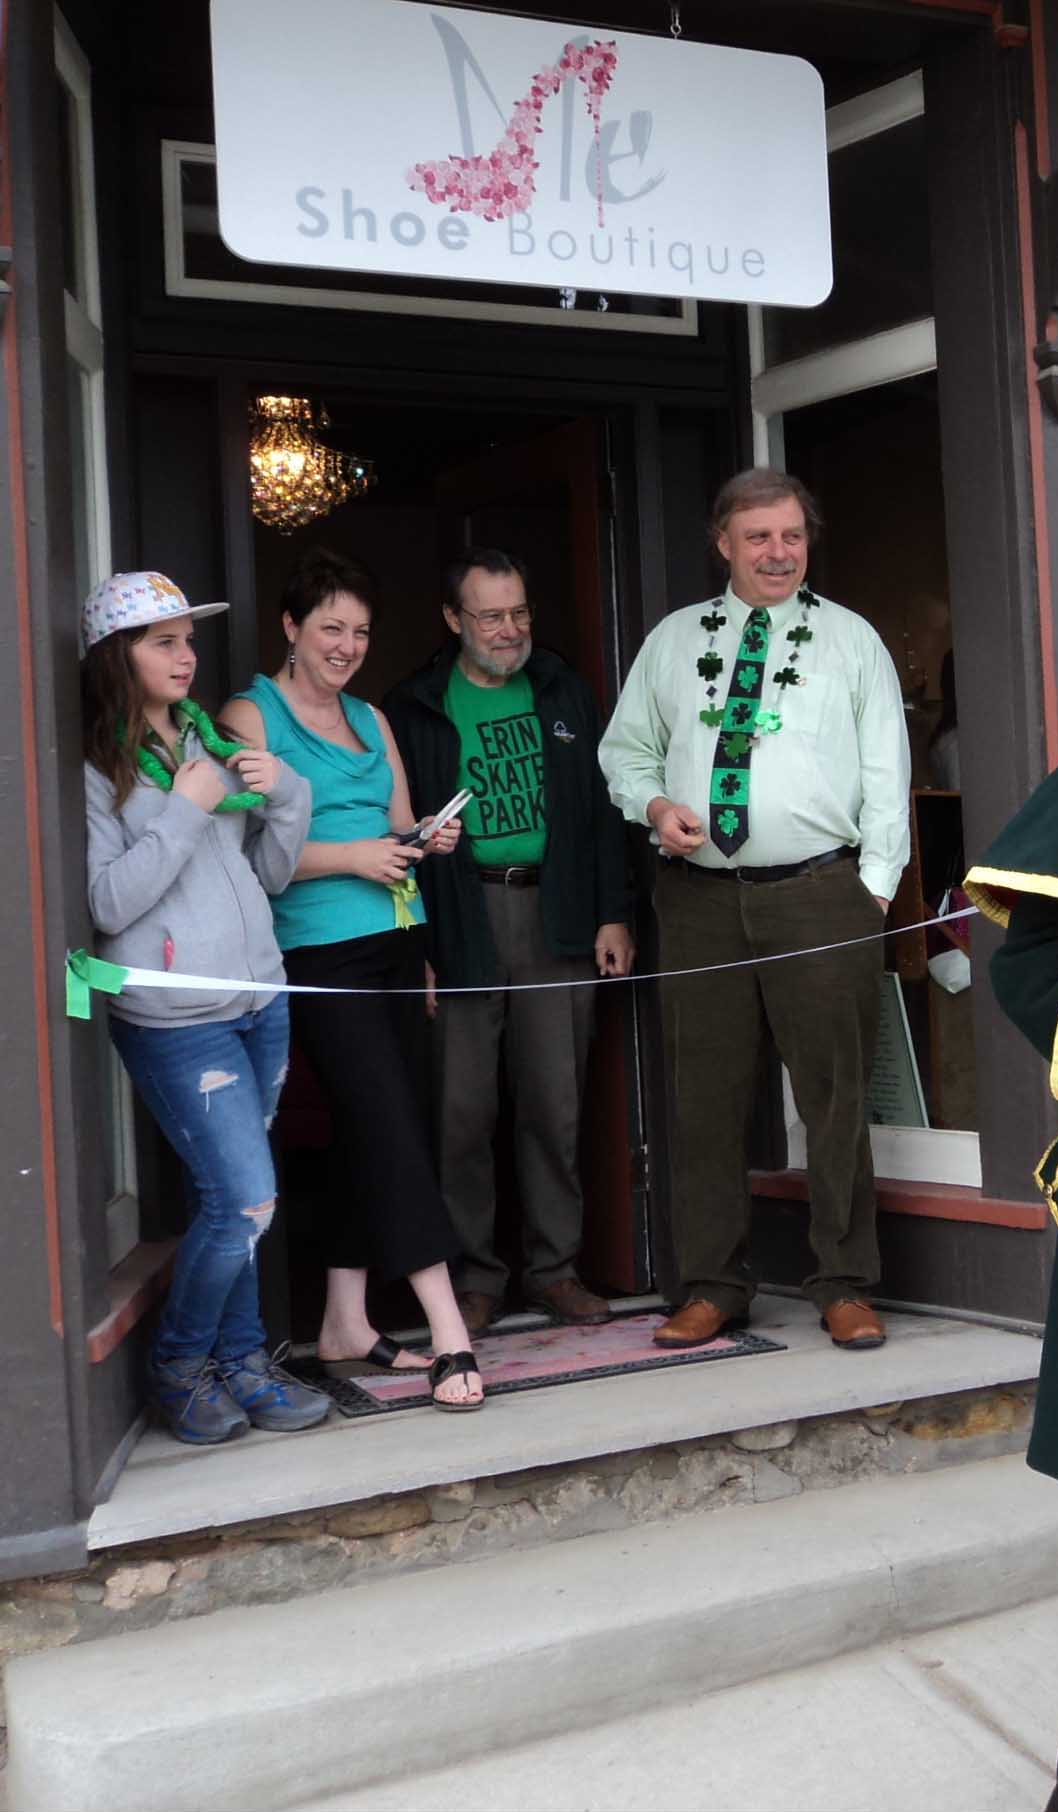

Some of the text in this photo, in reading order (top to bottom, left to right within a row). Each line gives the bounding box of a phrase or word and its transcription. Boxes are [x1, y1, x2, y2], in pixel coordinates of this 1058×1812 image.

[295, 185, 766, 284] Shoe Boutique
[476, 719, 539, 760] ERIN
[467, 752, 545, 798] SKATE
[479, 788, 546, 834] PARK
